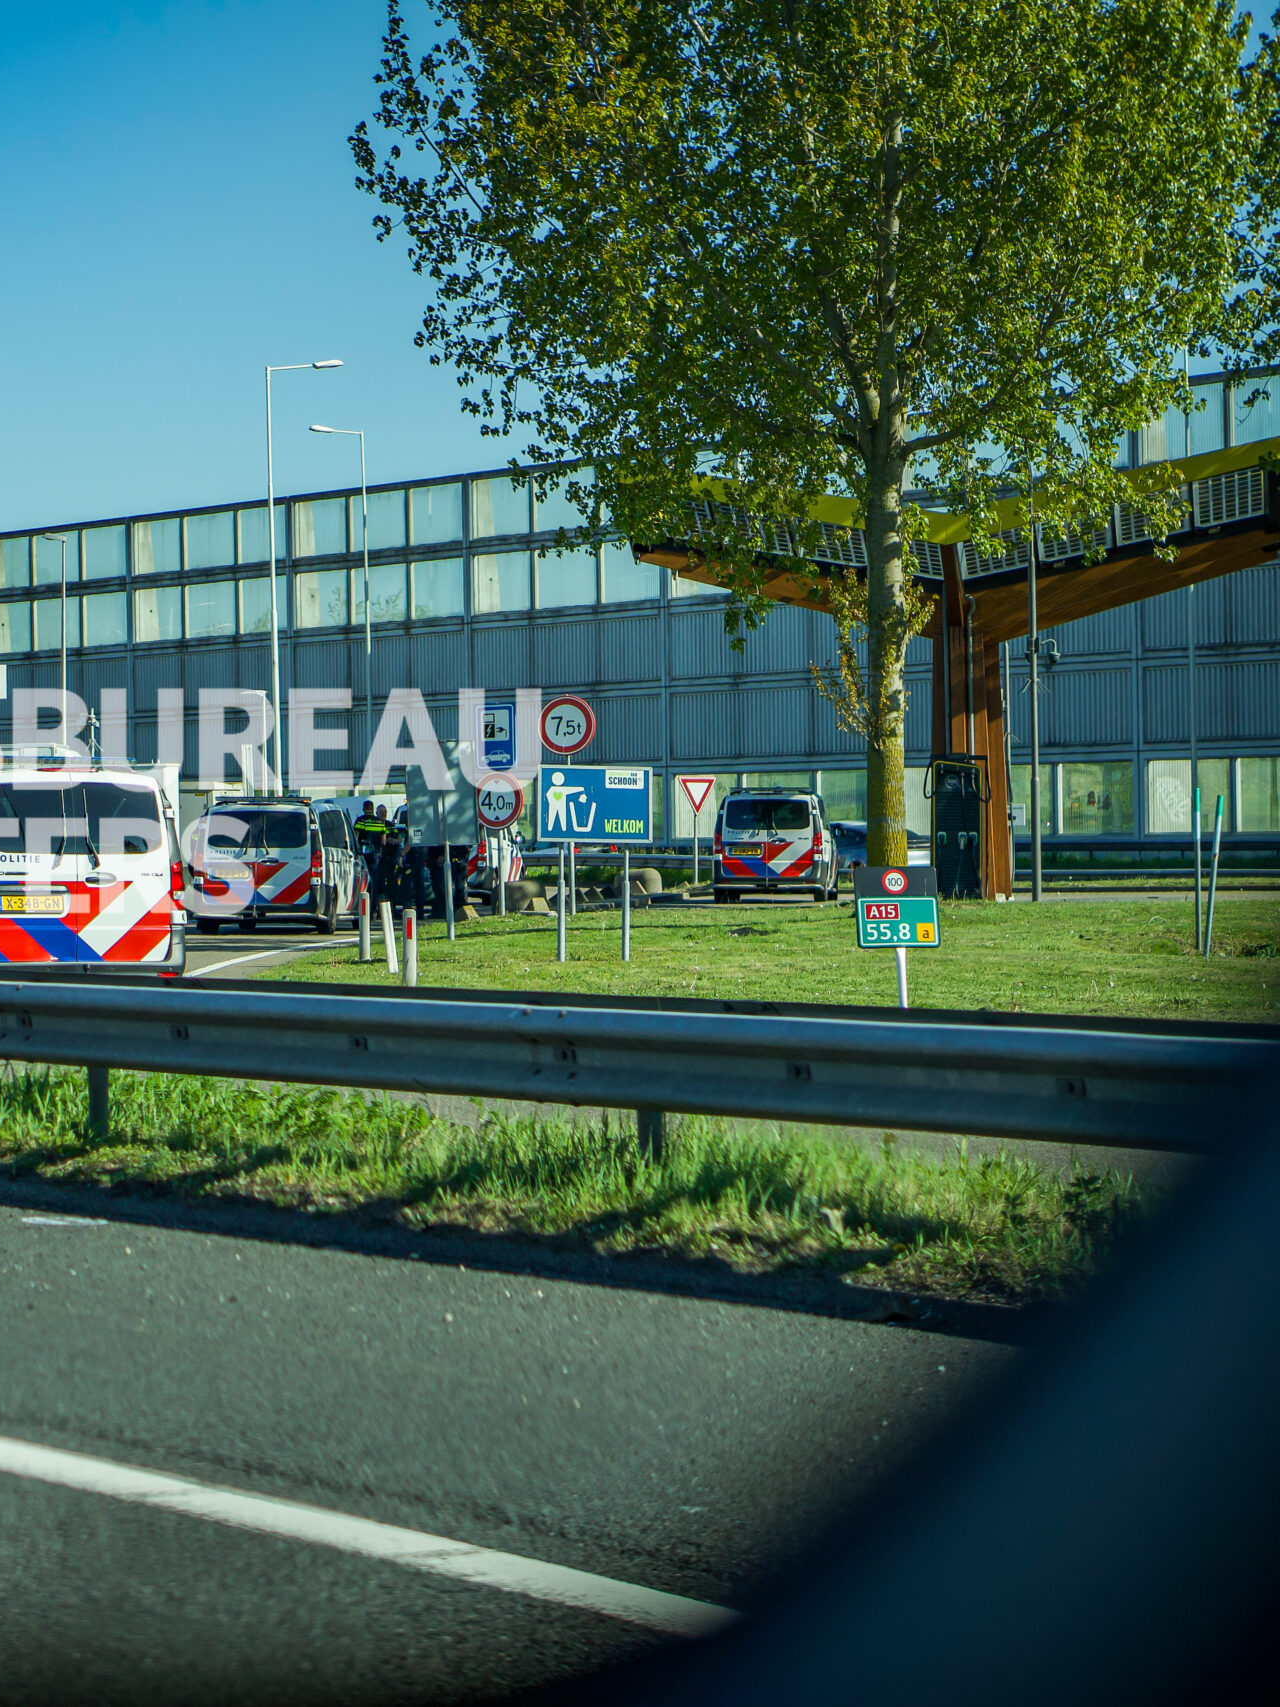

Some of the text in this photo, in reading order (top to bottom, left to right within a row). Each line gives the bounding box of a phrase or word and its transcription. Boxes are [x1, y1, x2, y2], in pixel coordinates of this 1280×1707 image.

[608, 776, 637, 785] SCHOON
[604, 818, 644, 834] WELKOM
[887, 877, 903, 887] 100
[7, 898, 59, 909] X-348-GN
[869, 905, 895, 918] A15
[866, 923, 929, 942] 55,8 a
